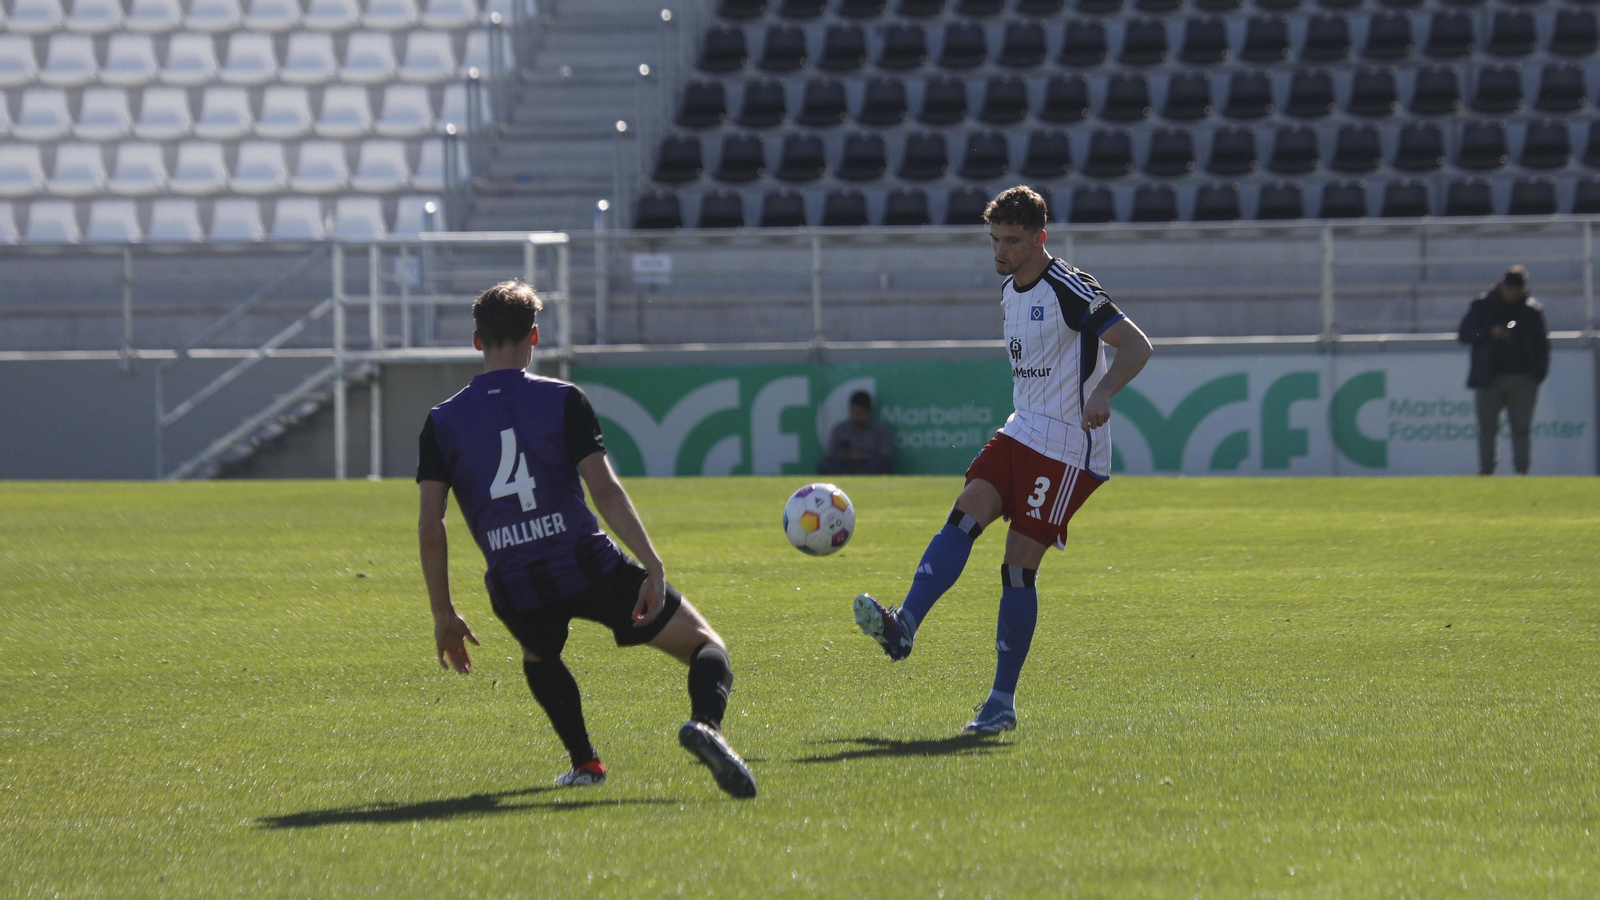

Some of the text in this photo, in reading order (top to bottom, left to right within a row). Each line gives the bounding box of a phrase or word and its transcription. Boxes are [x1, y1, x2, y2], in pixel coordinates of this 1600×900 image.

[1013, 366, 1052, 378] Merkur
[881, 403, 993, 425] Marbella
[1389, 398, 1475, 417] Marbe
[892, 427, 983, 448] ootball
[1389, 421, 1479, 441] Footba
[490, 427, 536, 512] 4
[1027, 476, 1051, 508] 3
[487, 512, 567, 551] WALLNER
